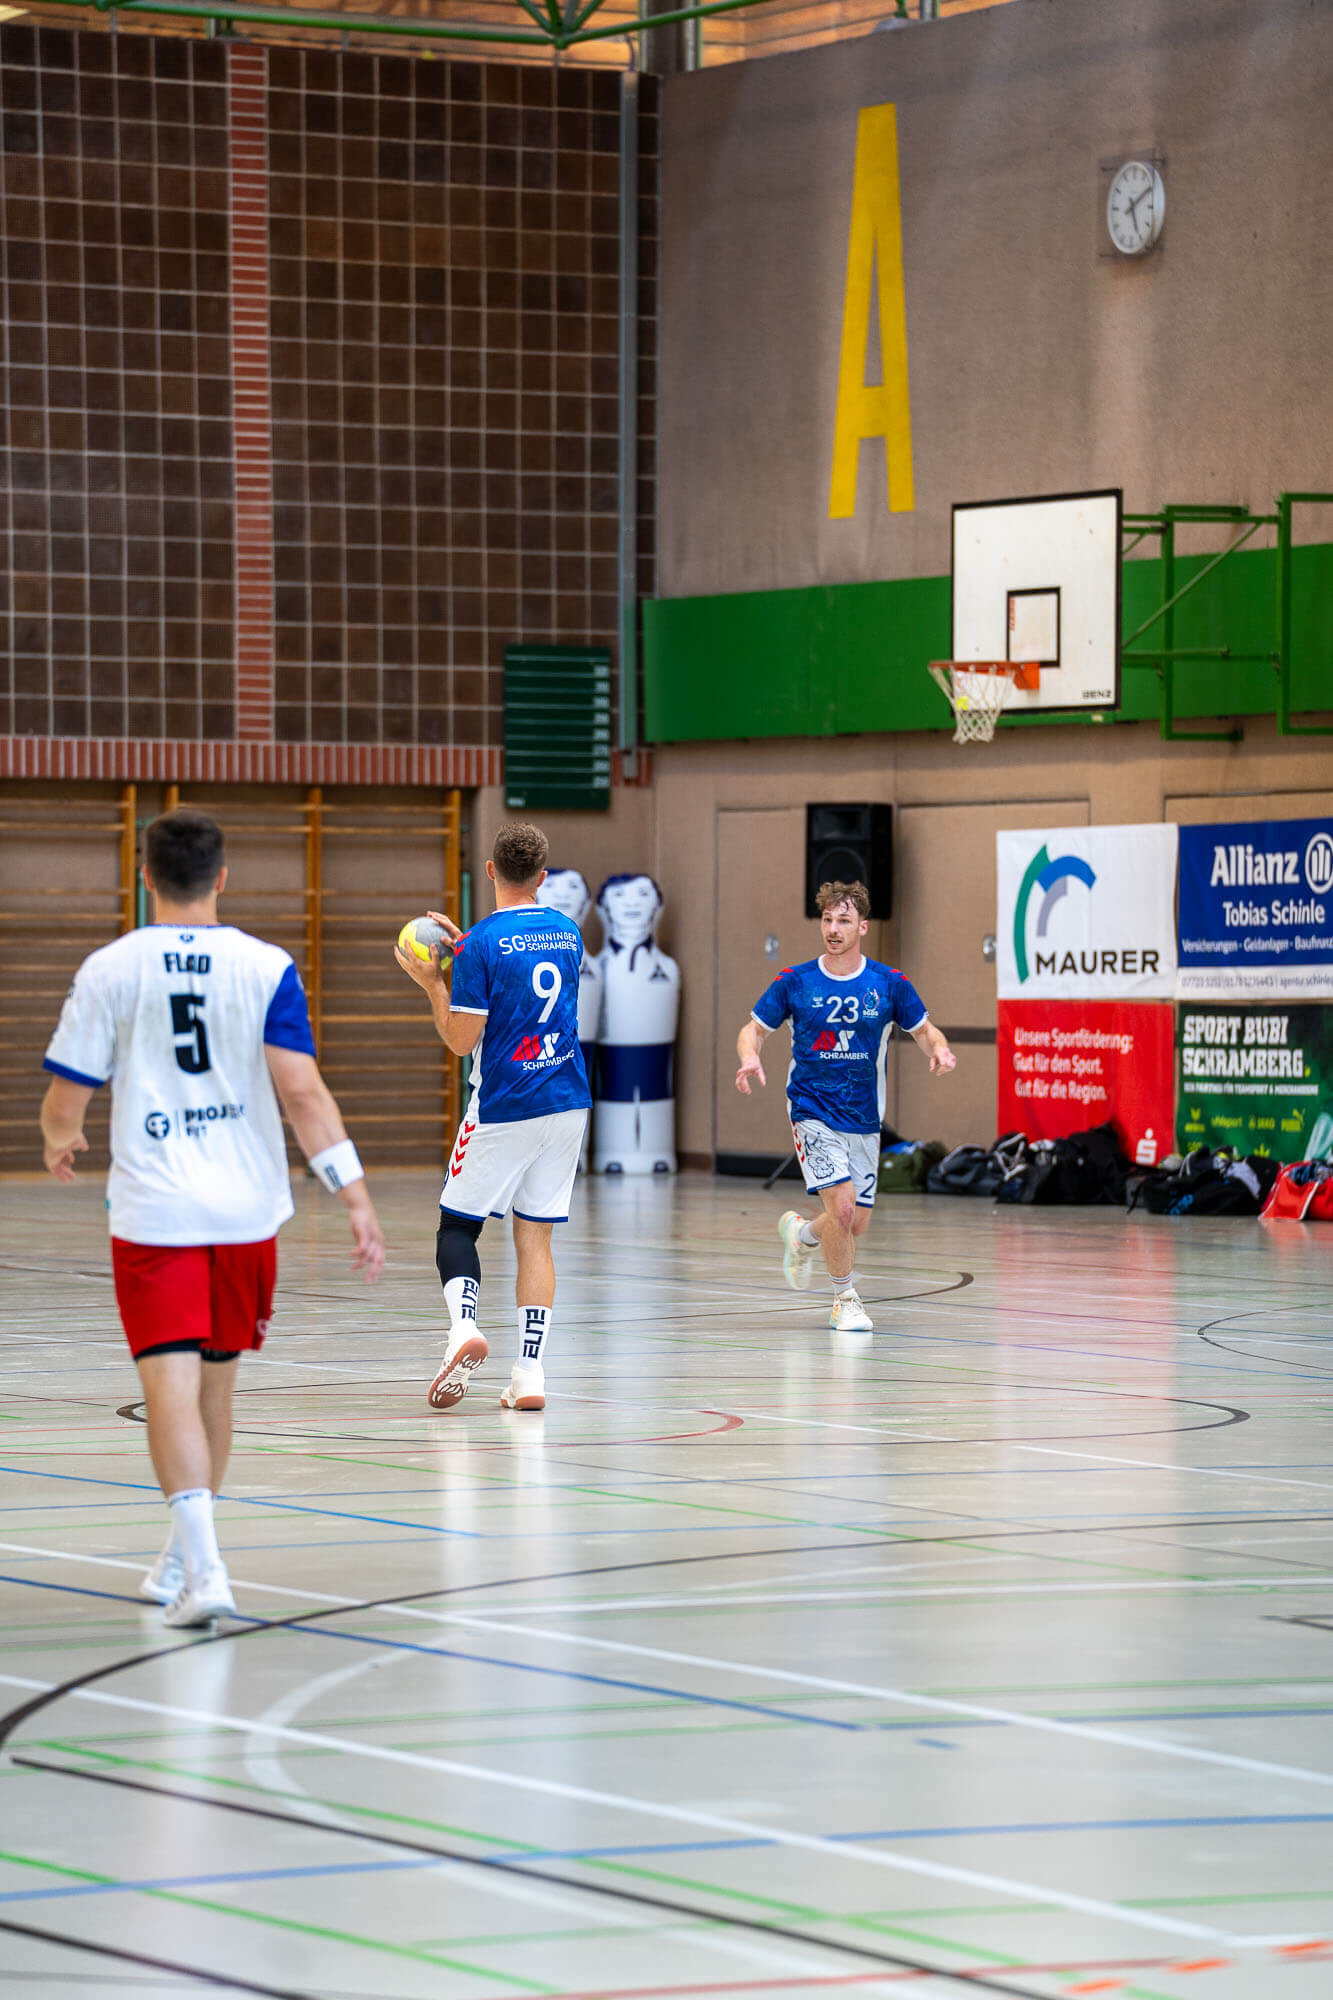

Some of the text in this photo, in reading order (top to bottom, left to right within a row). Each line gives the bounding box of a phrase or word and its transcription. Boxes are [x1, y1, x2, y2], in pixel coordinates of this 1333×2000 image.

[829, 102, 915, 518] A
[1211, 844, 1300, 887] Allianz
[1222, 898, 1325, 927] Tobias Schinle
[498, 934, 526, 955] SG
[524, 931, 577, 943] DUNNINGEN
[1035, 950, 1160, 975] MAURER
[532, 961, 562, 1024] 9
[826, 995, 859, 1024] 23
[169, 993, 212, 1075] 5
[1014, 1027, 1050, 1047] Unsere
[1183, 1015, 1289, 1045] SPORT BUBI
[1013, 1052, 1104, 1078] Gut für den Sport.
[1014, 1077, 1107, 1105] Gut für die Region.
[523, 1308, 545, 1360] ELITE
